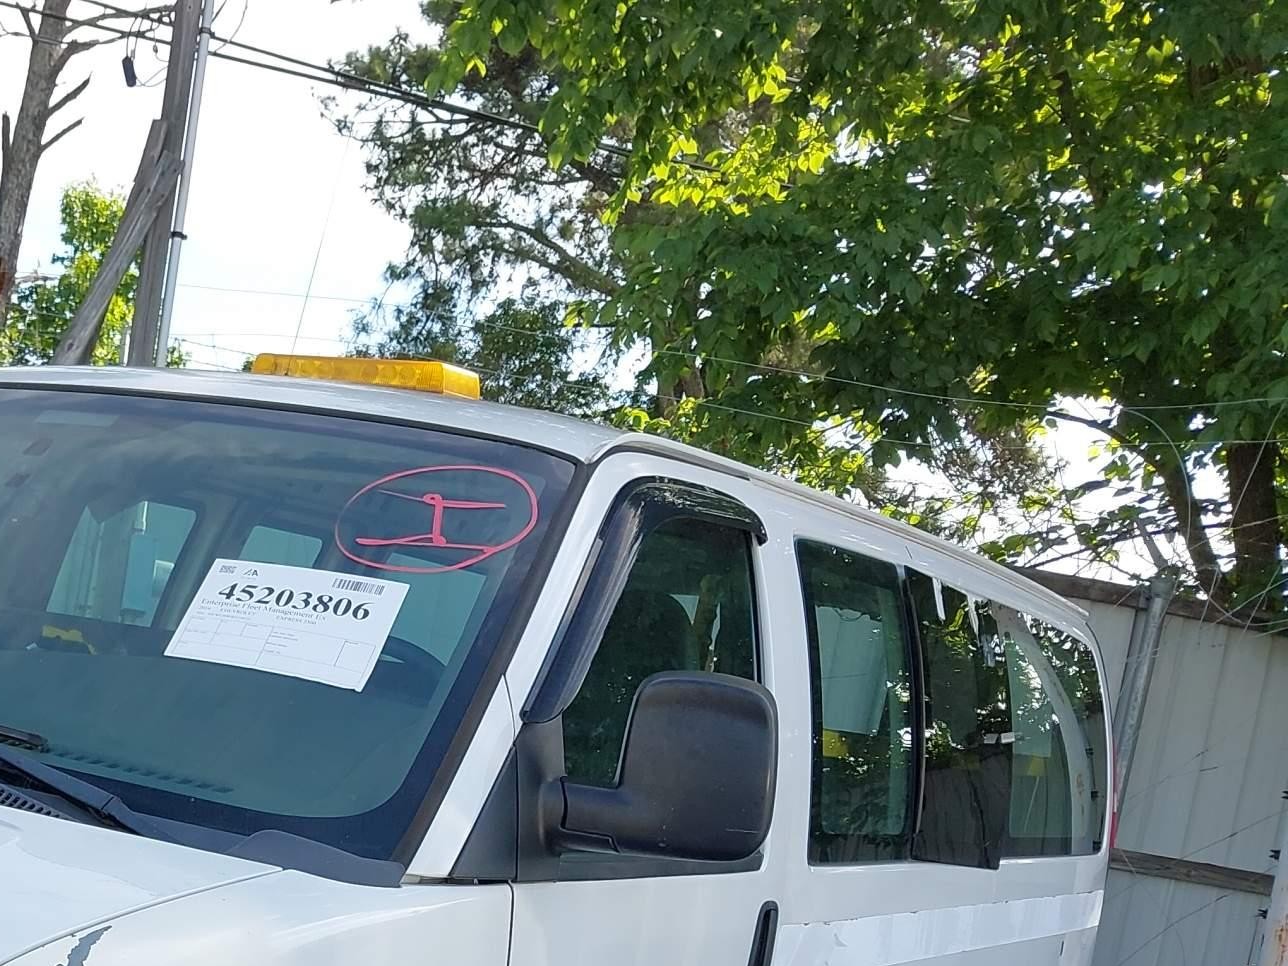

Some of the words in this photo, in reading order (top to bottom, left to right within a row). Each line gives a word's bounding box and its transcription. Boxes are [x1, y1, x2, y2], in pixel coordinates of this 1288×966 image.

[201, 598, 241, 608] Enterprise
[242, 603, 262, 611] Fleet
[218, 582, 375, 621] 45203806
